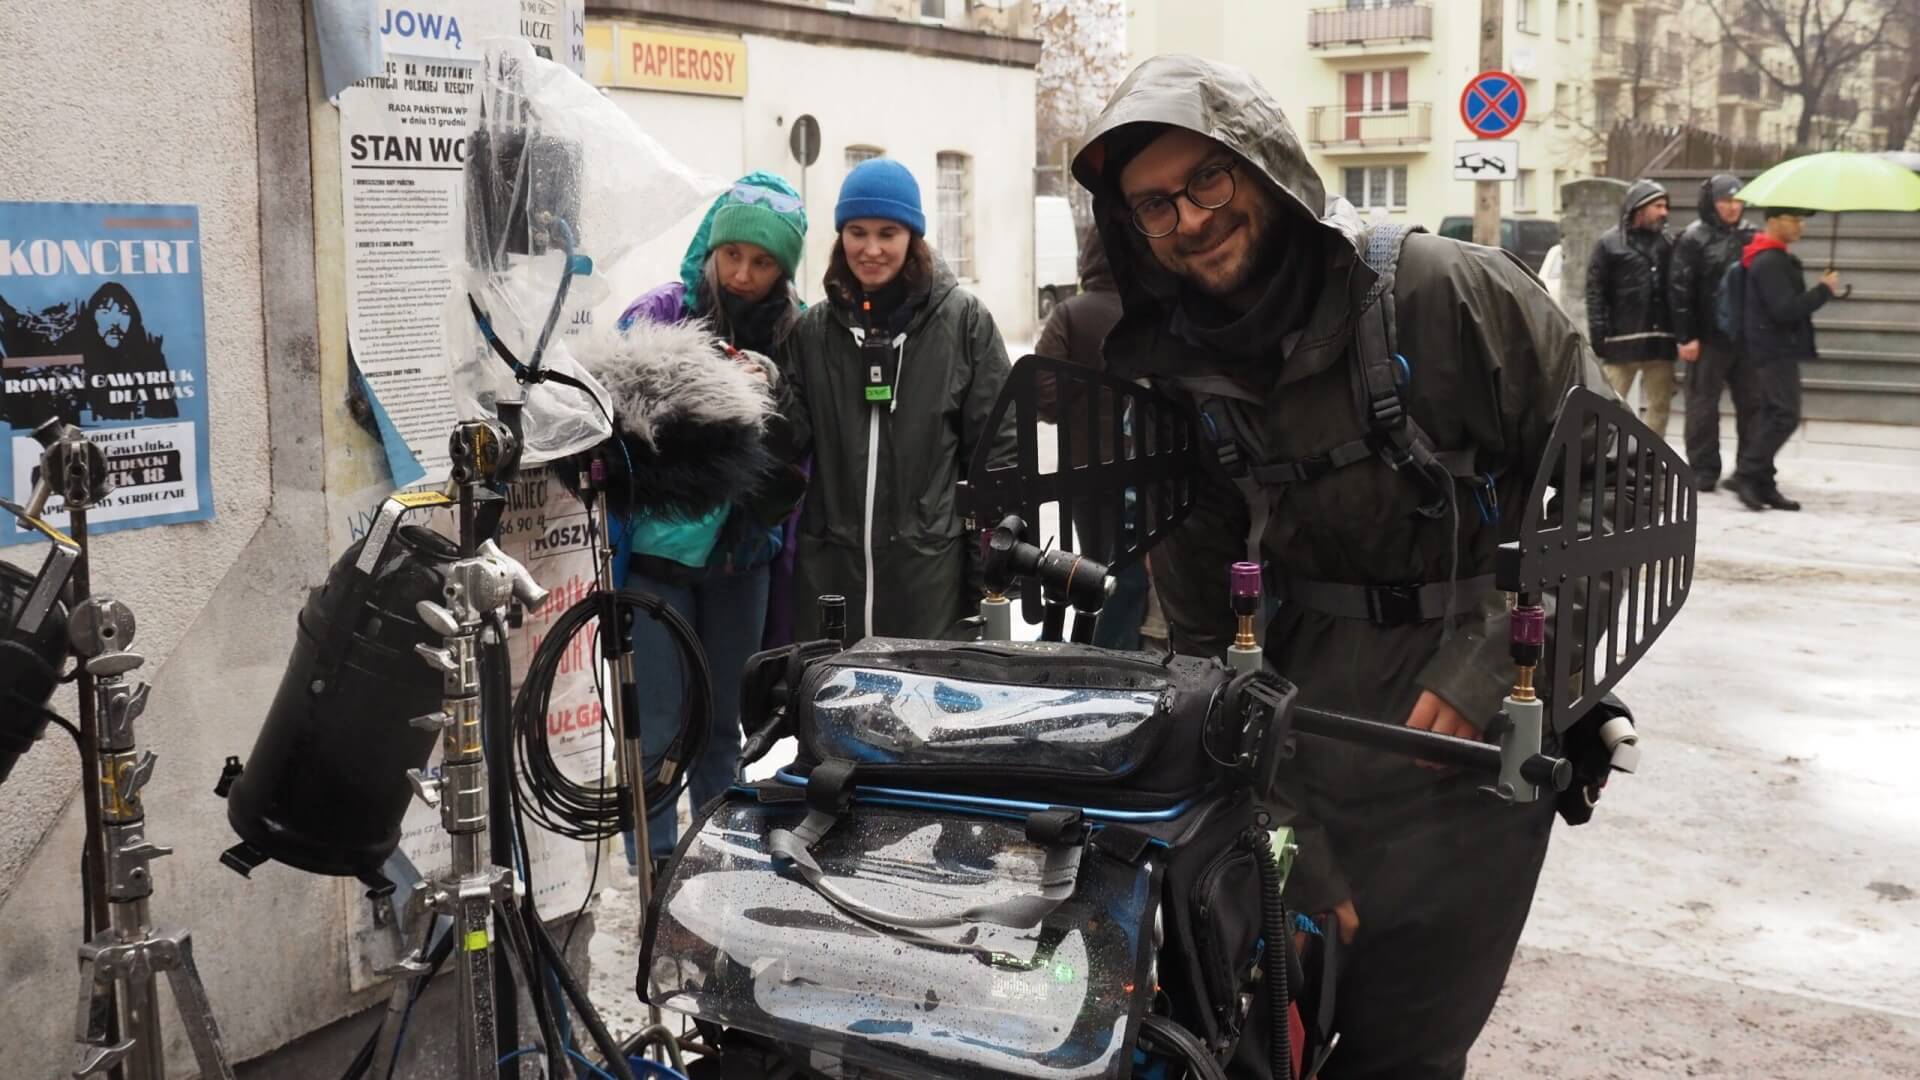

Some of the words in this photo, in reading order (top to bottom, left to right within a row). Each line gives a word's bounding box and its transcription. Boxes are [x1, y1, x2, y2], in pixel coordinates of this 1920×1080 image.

[380, 9, 462, 50] JOWĄ
[632, 42, 736, 83] PAPIEROSY
[405, 63, 417, 75] NA
[425, 65, 473, 80] PODSTAWIE
[404, 80, 438, 93] POLSKIEJ
[388, 103, 412, 113] RADA
[414, 104, 453, 115] PAŃSTWA
[409, 116, 427, 126] dniu
[428, 118, 437, 126] 13
[350, 134, 422, 161] STAN
[0, 240, 194, 276] KONCERT
[5, 377, 86, 394] ROMAN
[109, 389, 148, 404] DLA
[154, 385, 194, 401] WAS
[81, 429, 135, 442] oncert
[107, 455, 168, 471] TUDENCKI
[143, 467, 165, 483] 18
[118, 488, 185, 505] SERDECZNIE
